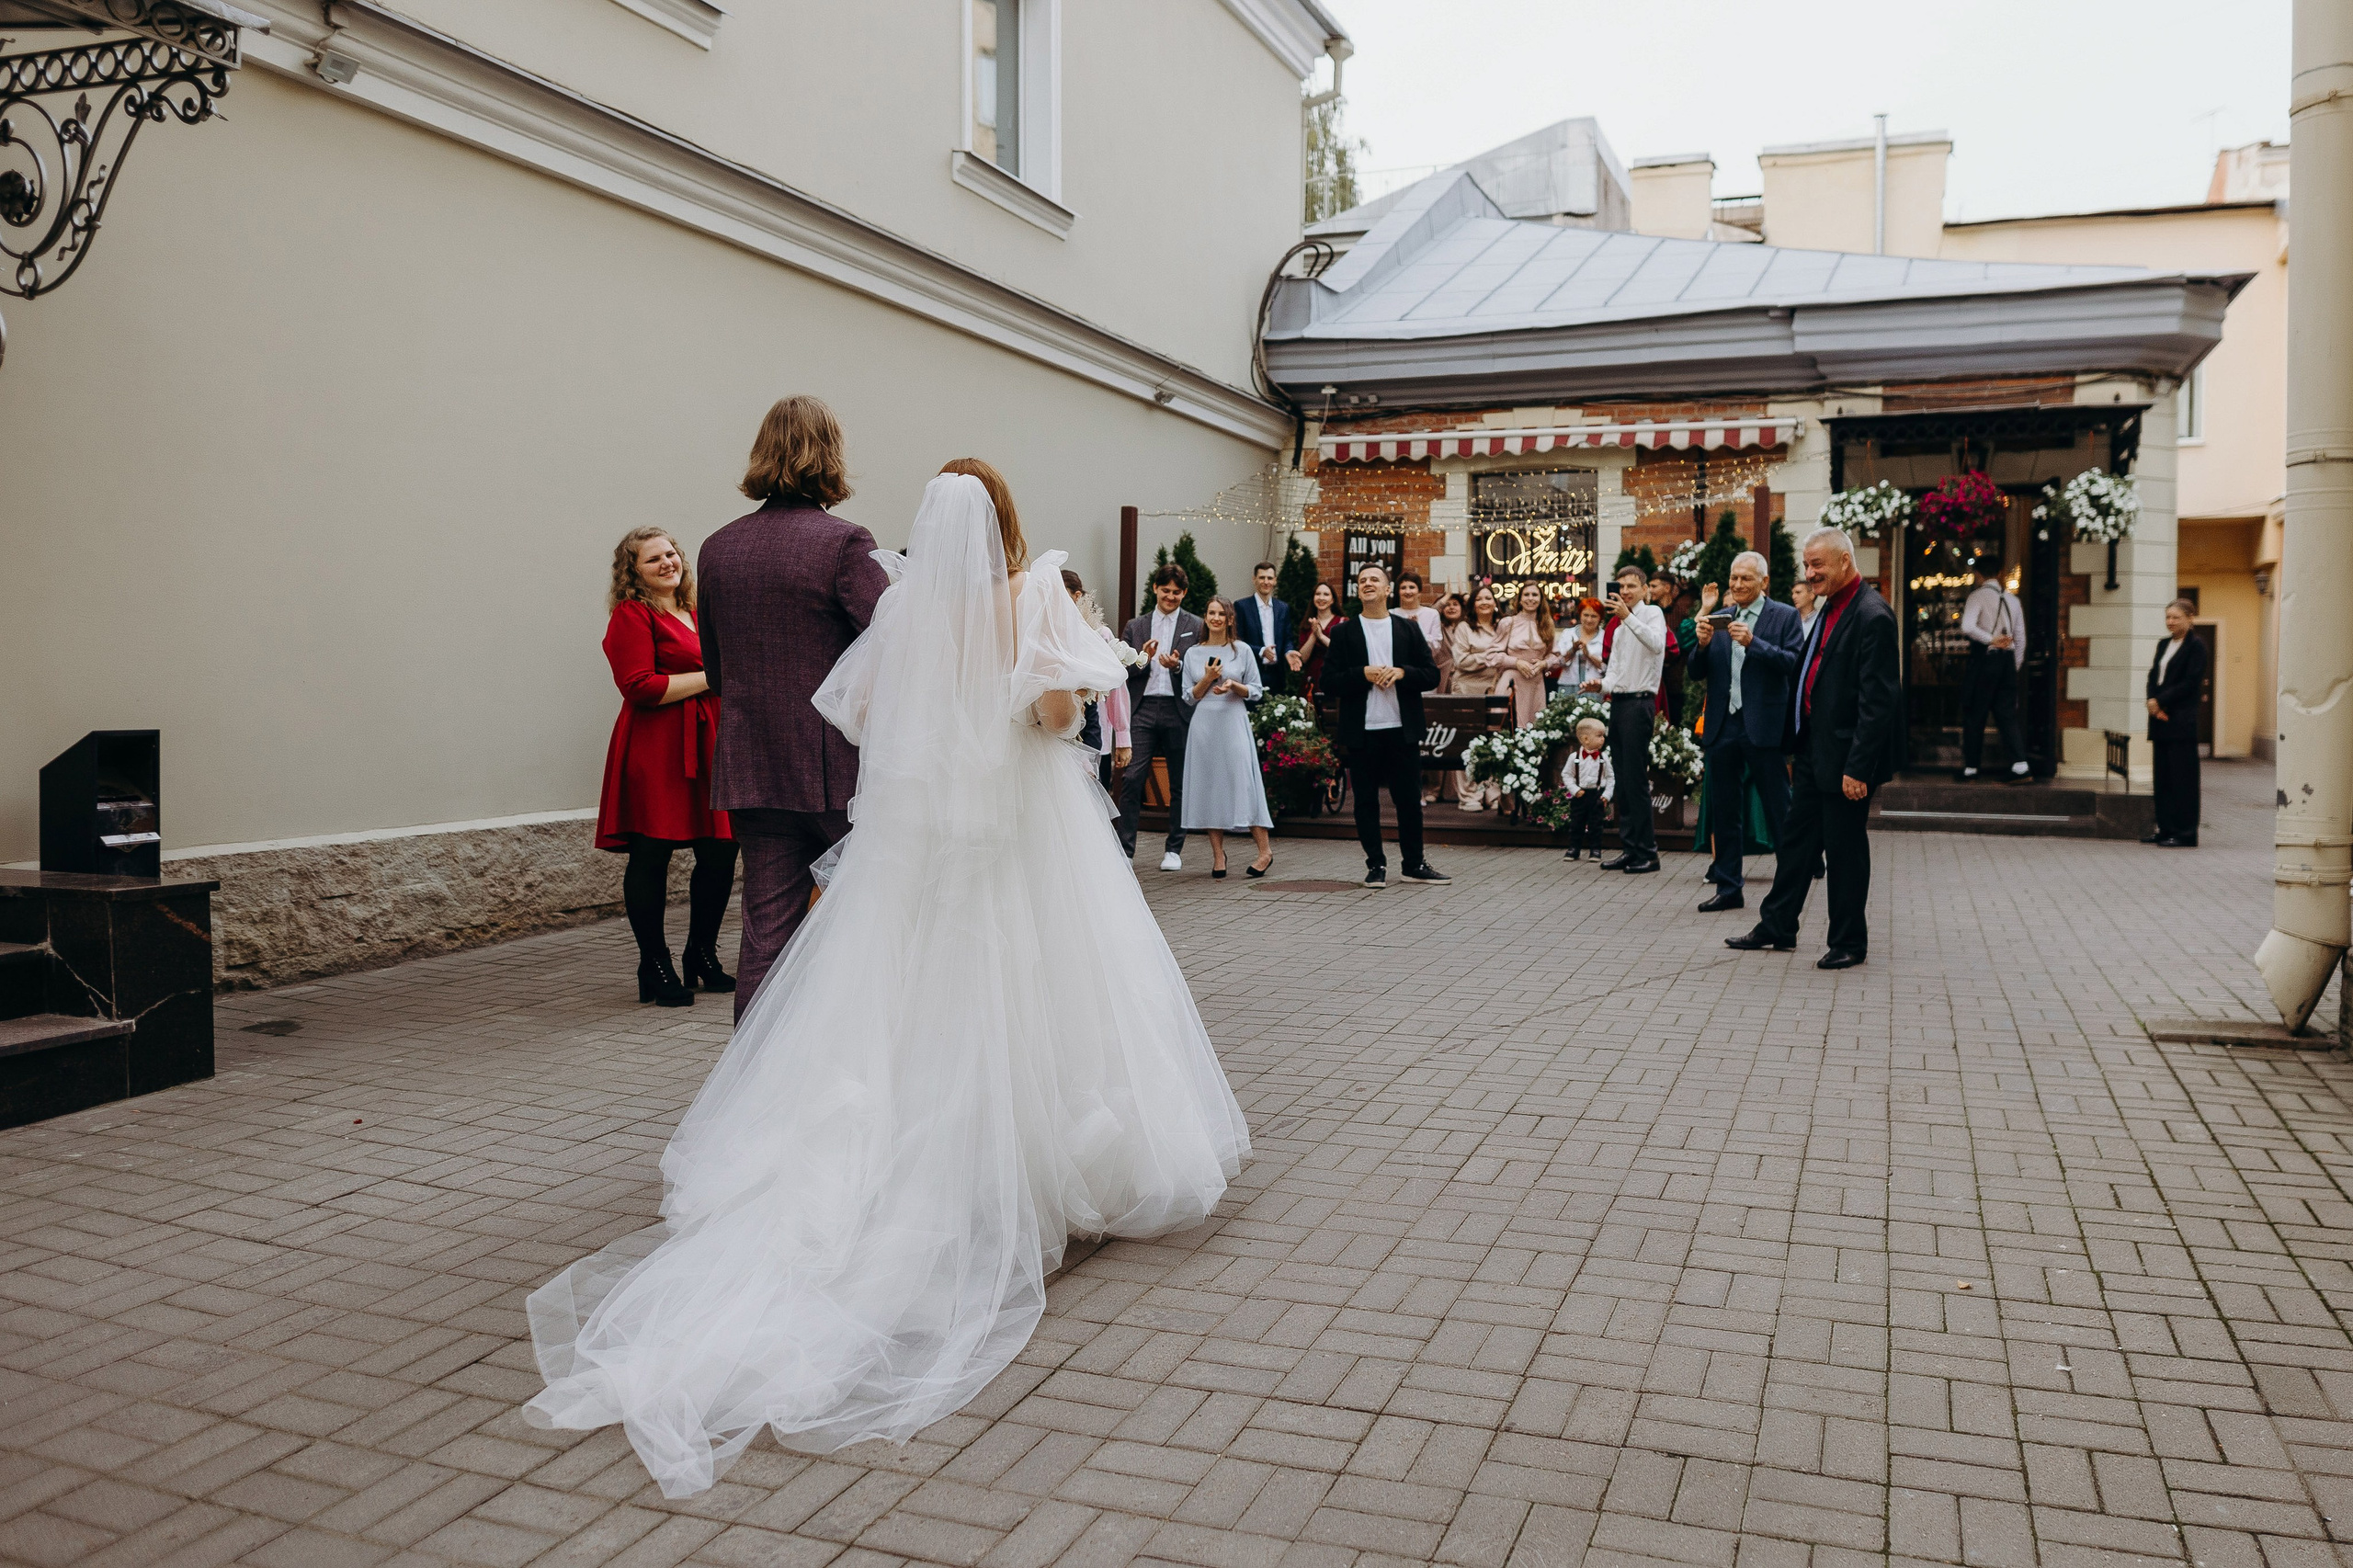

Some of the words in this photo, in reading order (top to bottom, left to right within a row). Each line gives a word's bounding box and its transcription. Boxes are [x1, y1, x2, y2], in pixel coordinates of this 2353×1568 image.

[1348, 537, 1368, 554] All
[1370, 539, 1395, 556] you
[1418, 721, 1458, 758] ity
